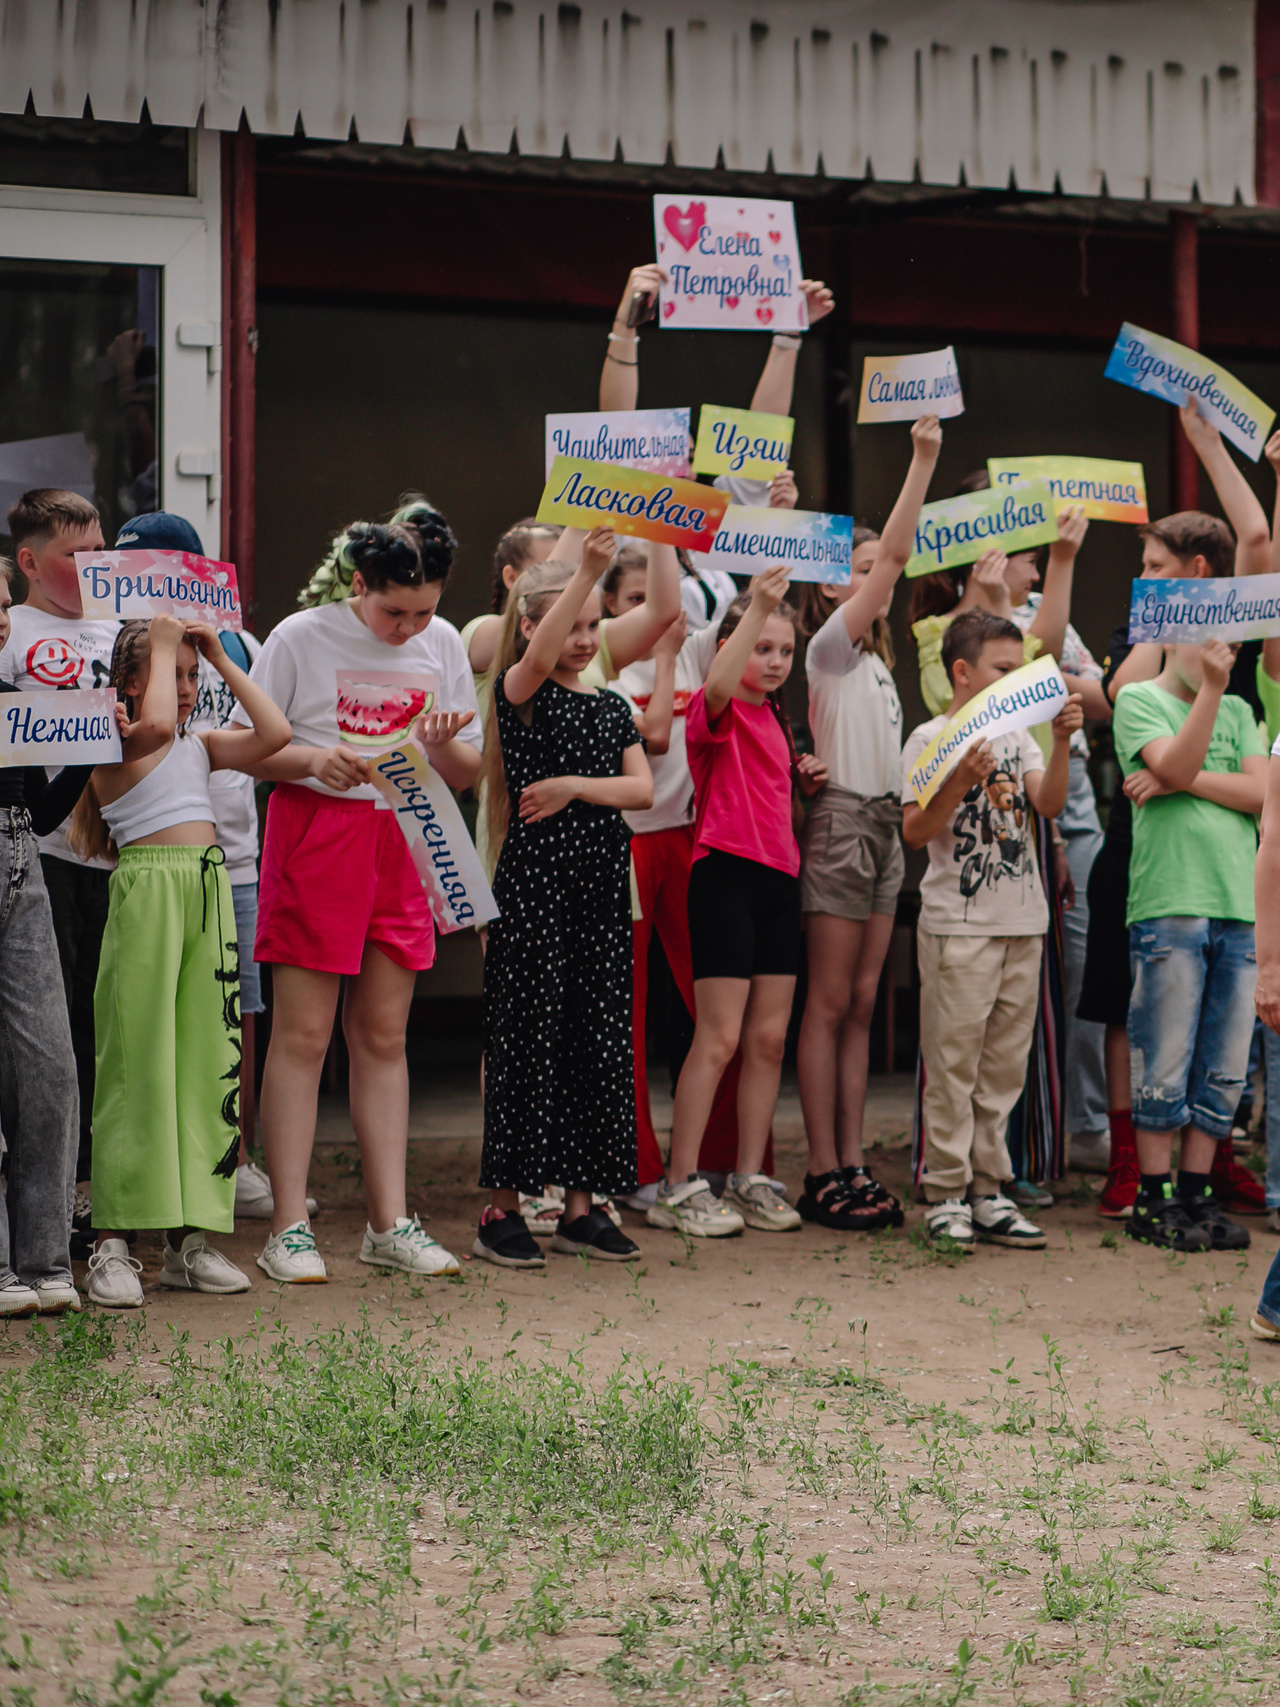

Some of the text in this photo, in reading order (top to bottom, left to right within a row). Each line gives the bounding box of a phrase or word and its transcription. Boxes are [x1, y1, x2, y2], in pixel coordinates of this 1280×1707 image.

[699, 226, 763, 256] Елена
[670, 264, 792, 309] Петровна!
[868, 371, 926, 403] Самая
[1125, 340, 1257, 439] Вдохновенная
[553, 472, 707, 531] Ласковая
[714, 529, 850, 564] амечательная
[915, 495, 1047, 563] Красивая
[82, 566, 237, 613] Брильянт
[7, 707, 112, 743] Нежная
[912, 676, 1064, 793] Необыкновенная
[377, 751, 475, 926] Искренняя
